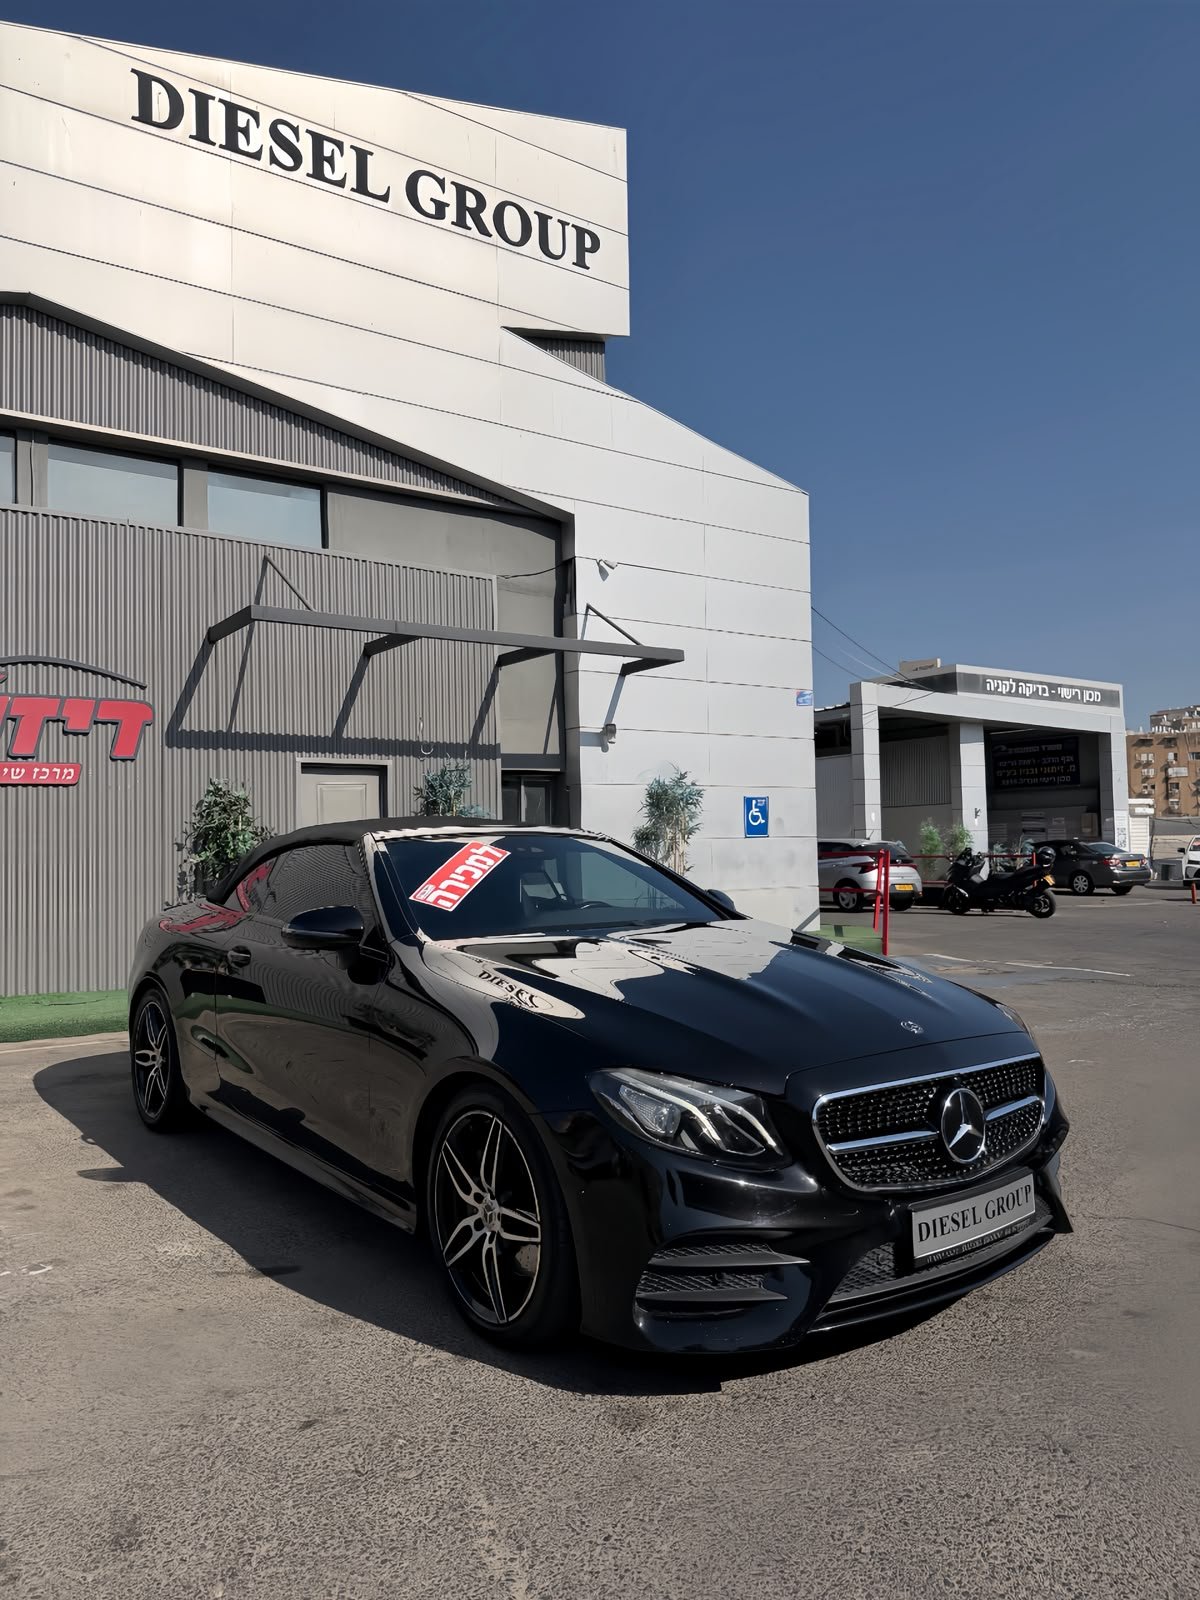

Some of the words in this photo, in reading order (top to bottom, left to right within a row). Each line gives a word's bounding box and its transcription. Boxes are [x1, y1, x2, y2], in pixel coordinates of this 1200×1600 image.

[130, 68, 391, 203] DIESEL
[405, 169, 601, 271] GROUP
[986, 678, 1016, 694] לקניה
[1018, 682, 1050, 697] בדיקה
[1057, 687, 1081, 700] רישוי
[1083, 689, 1101, 703] מכון
[0, 694, 154, 759] דיז
[32, 767, 75, 780] מרכז
[426, 845, 503, 908] למכירה
[917, 1205, 982, 1243] DIESEL
[984, 1184, 1031, 1220] GROUP
